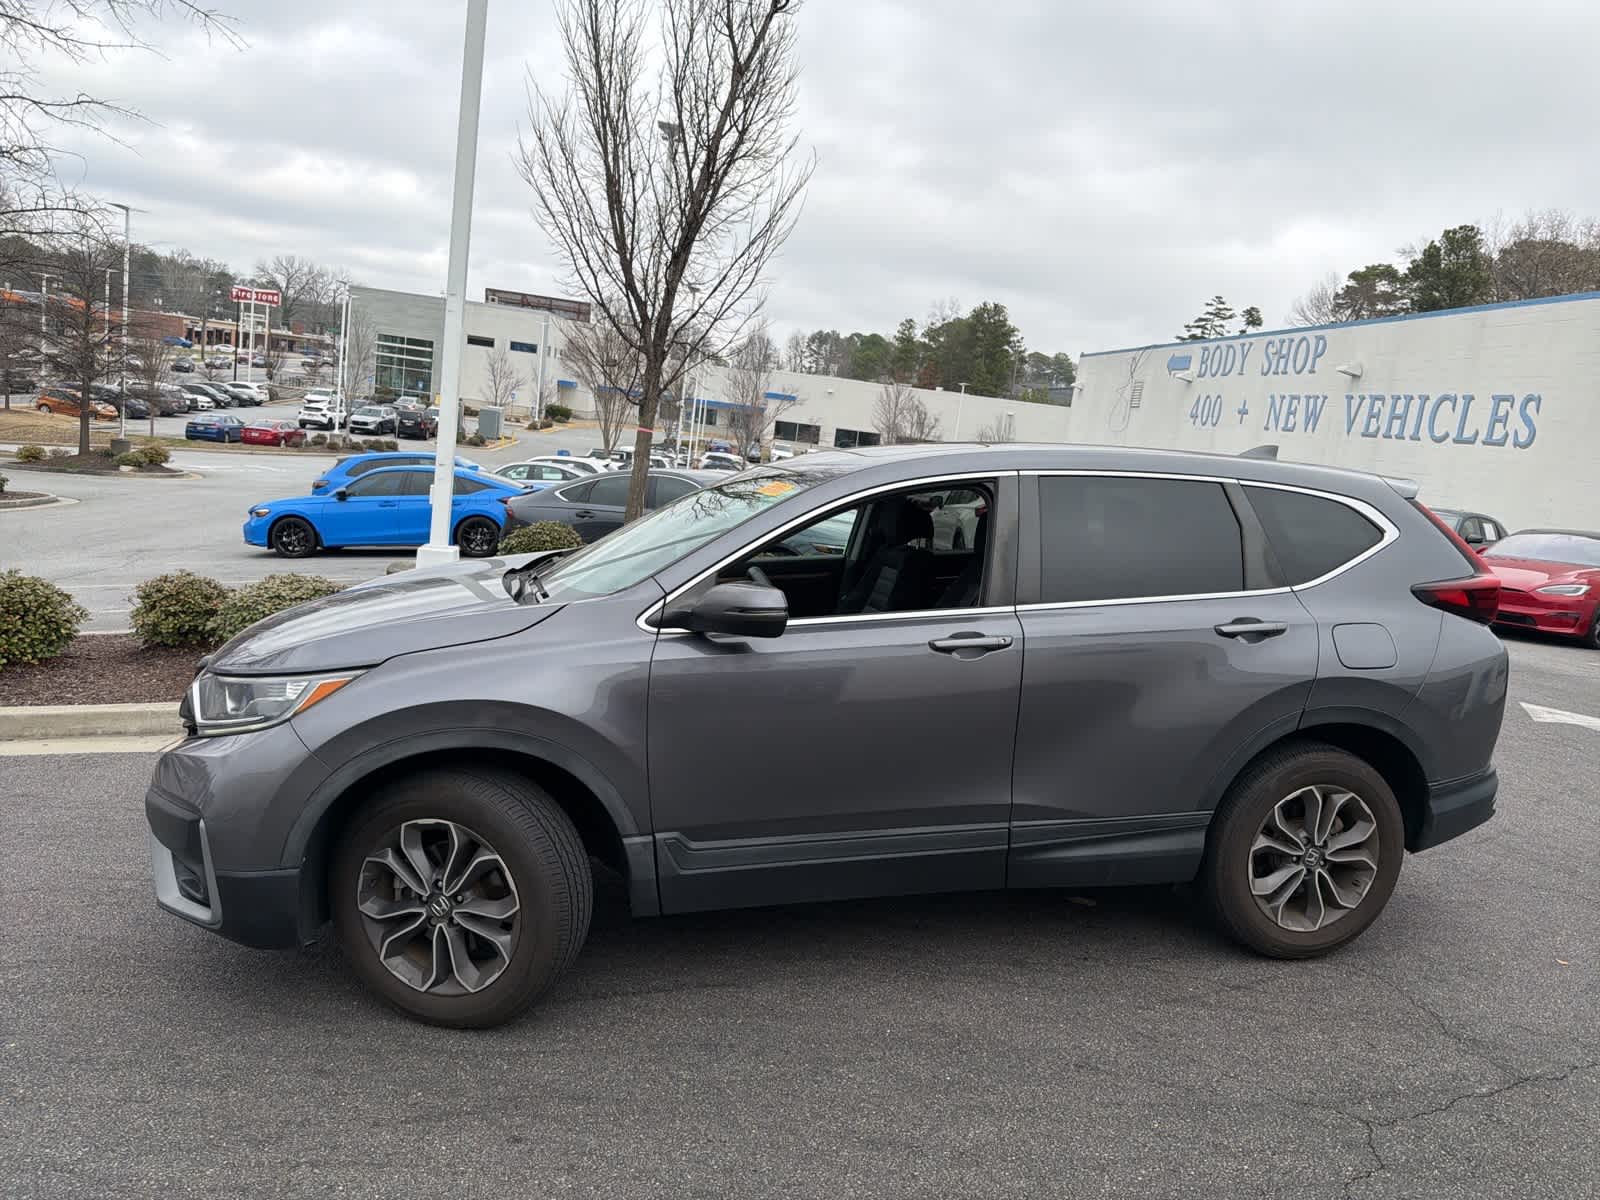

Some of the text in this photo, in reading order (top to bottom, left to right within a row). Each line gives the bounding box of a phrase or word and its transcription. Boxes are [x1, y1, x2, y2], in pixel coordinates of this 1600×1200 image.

[1197, 335, 1328, 378] BODY SHOP
[1189, 394, 1223, 427] 400
[1264, 393, 1328, 433] NEW
[1344, 393, 1543, 450] VEHICLES
